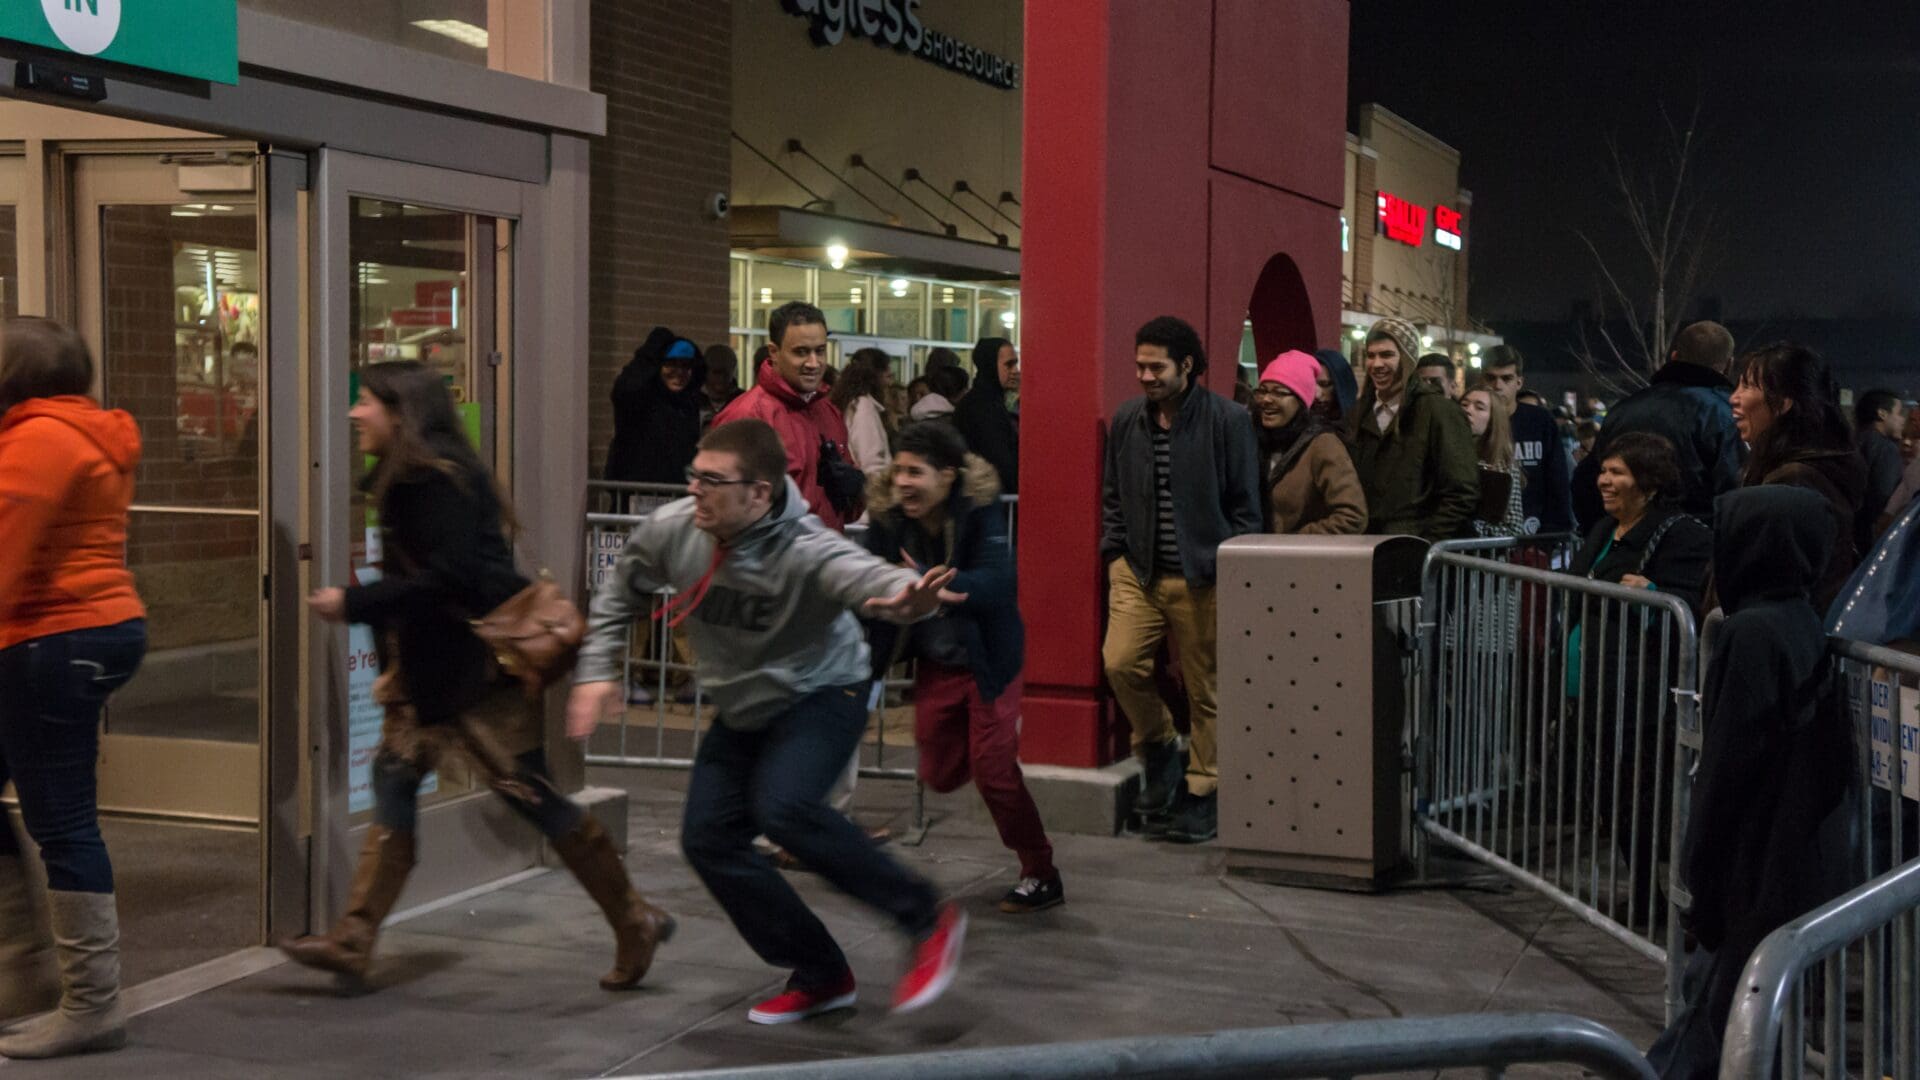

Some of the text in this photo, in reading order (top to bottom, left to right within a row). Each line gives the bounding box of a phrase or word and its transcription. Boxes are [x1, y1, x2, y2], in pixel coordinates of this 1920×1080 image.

[923, 28, 1019, 89] SHOESOURCE
[1515, 441, 1543, 460] AHO
[348, 649, 377, 671] e're
